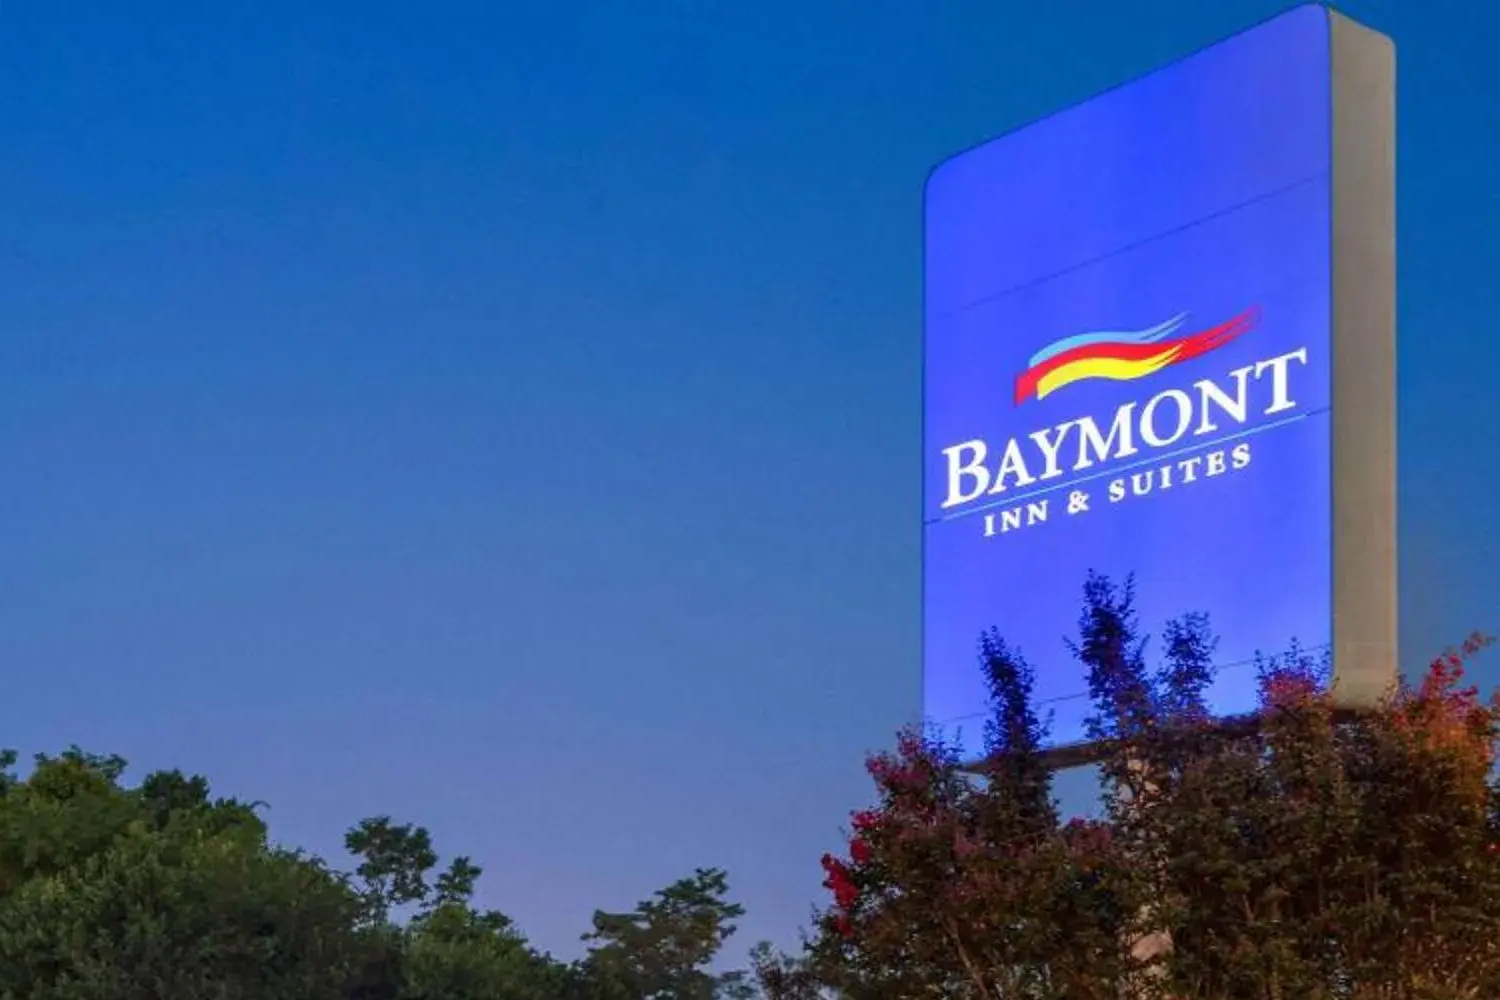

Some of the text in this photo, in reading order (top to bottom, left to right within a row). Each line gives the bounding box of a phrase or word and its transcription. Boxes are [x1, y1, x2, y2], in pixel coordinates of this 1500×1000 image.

[941, 347, 1307, 508] BAYMONT
[984, 442, 1252, 537] INN & SUITES
